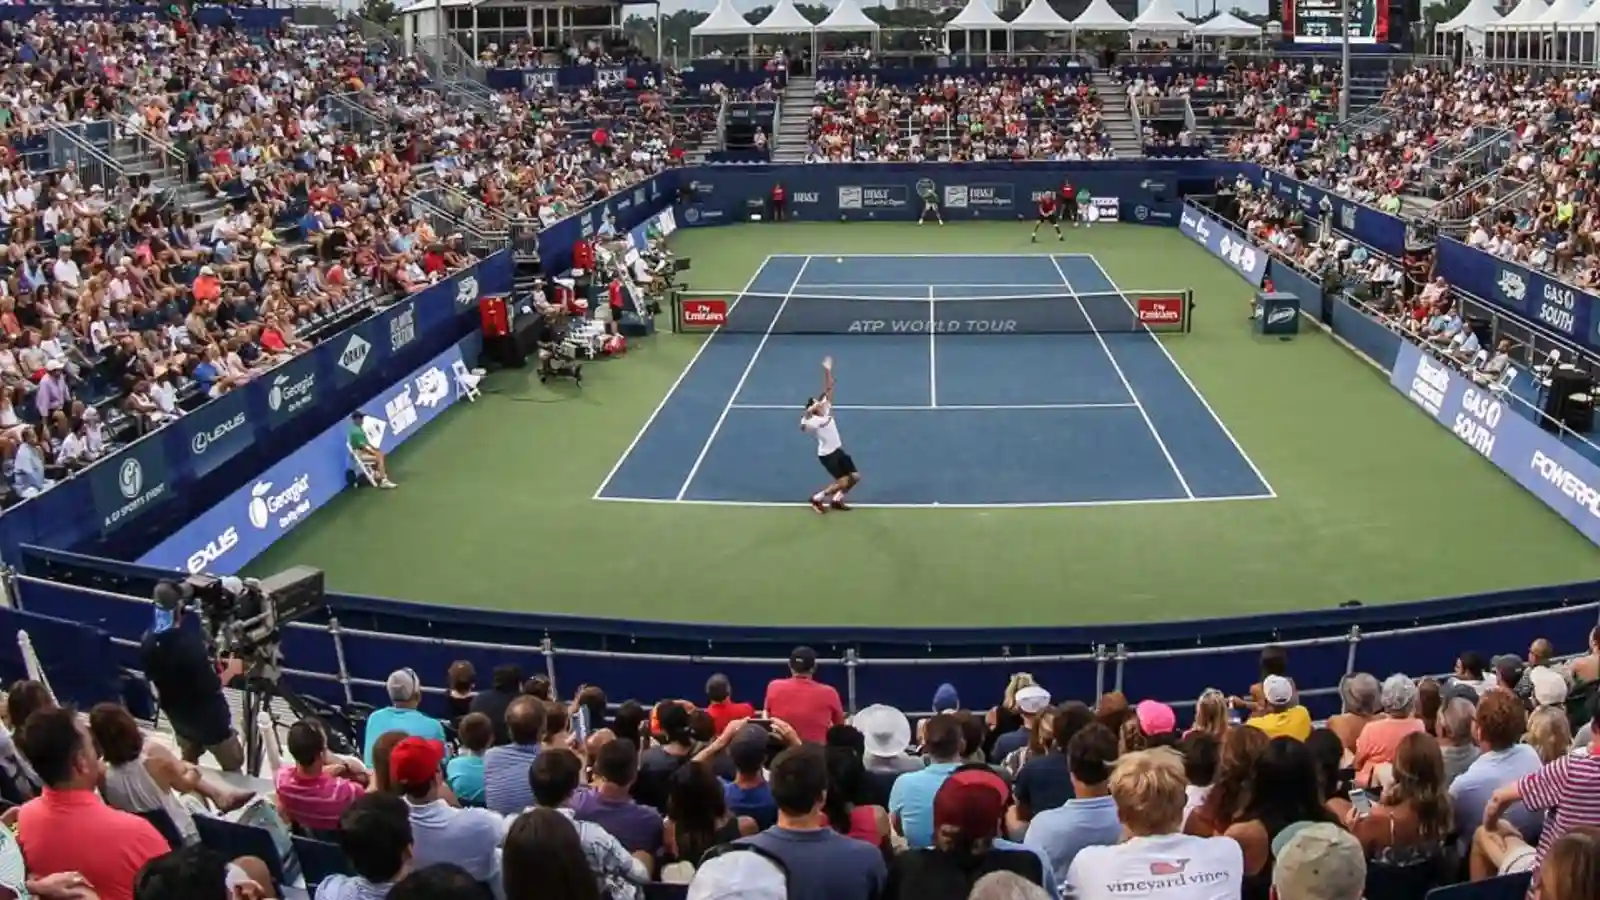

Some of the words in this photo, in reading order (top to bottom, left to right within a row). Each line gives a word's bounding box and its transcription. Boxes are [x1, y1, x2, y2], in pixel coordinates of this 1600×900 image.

[848, 320, 885, 333] ATP
[891, 320, 960, 333] WORLD
[965, 320, 1017, 333] TOUR
[1540, 302, 1575, 332] SOUTH
[207, 412, 246, 442] LEXUS
[1453, 412, 1496, 458] SOUTH
[267, 473, 310, 513] Georgia
[185, 525, 238, 574] EXUS
[1106, 873, 1187, 893] vineyard
[1187, 869, 1230, 884] vines
